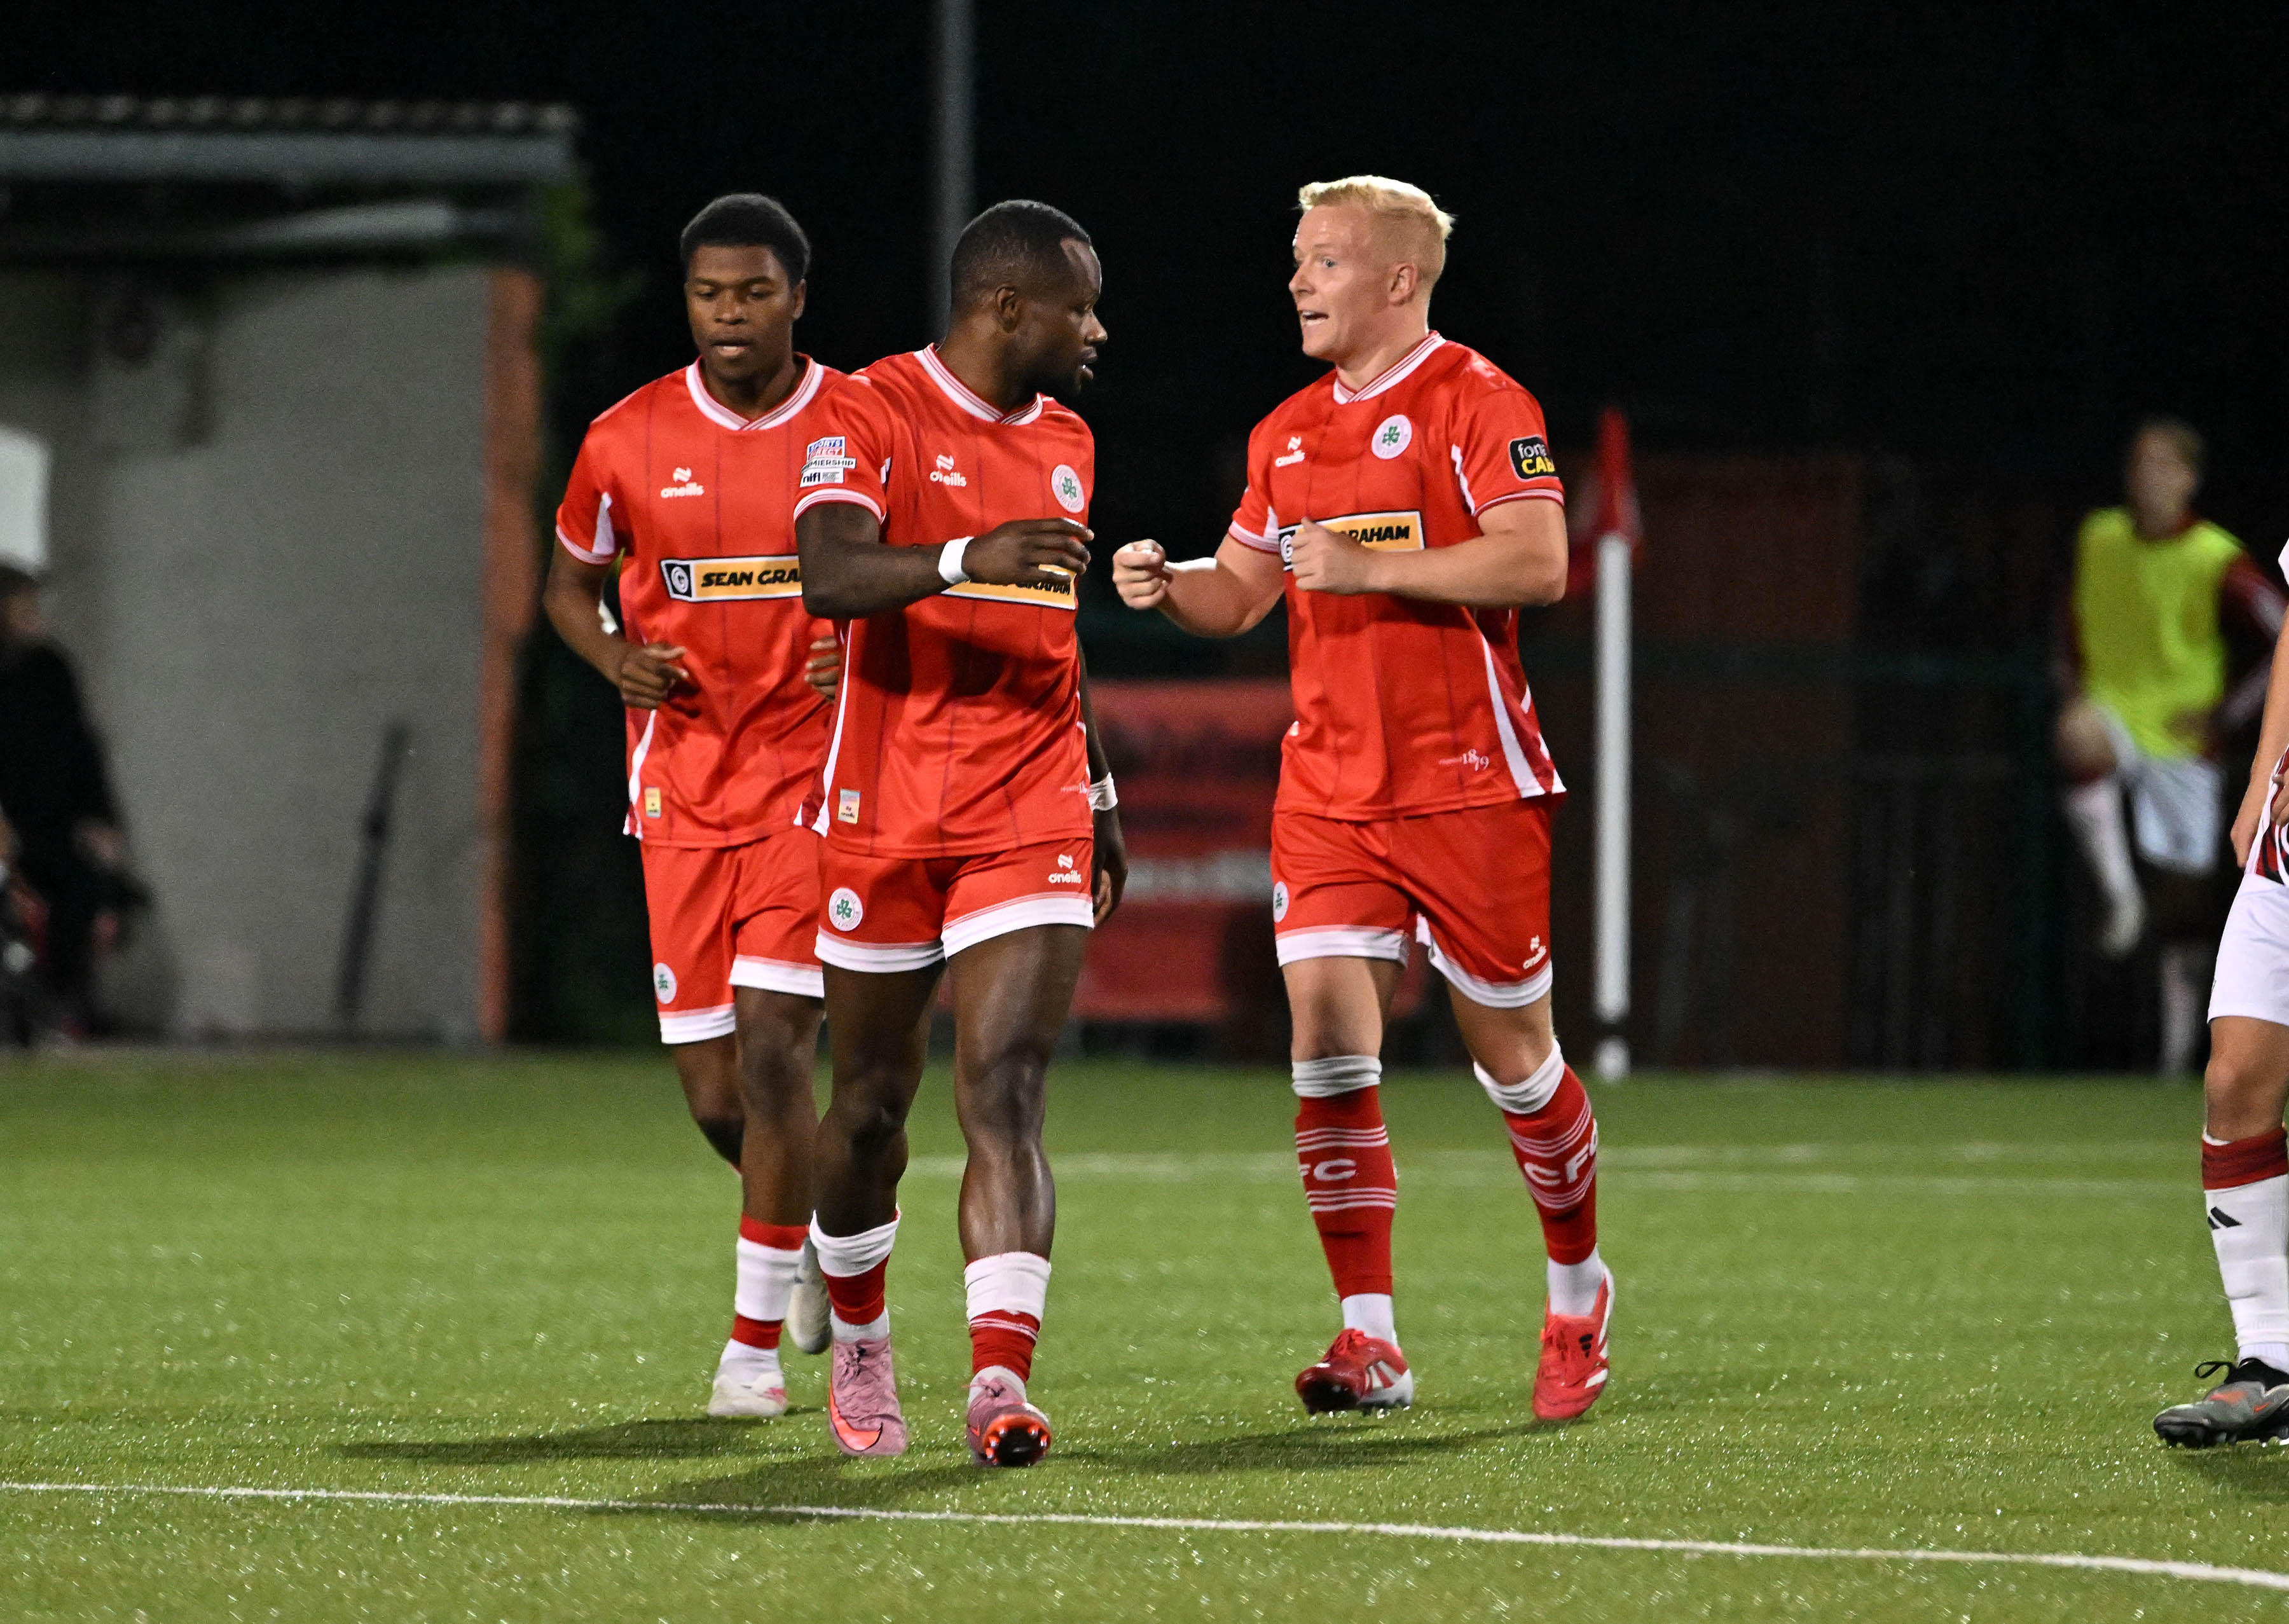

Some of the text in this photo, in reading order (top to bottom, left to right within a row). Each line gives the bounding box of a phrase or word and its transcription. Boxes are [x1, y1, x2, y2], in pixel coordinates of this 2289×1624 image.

[801, 459, 853, 472] MIERSHIP
[1348, 525, 1410, 543] RAHAM
[701, 568, 801, 588] SEAN GRA
